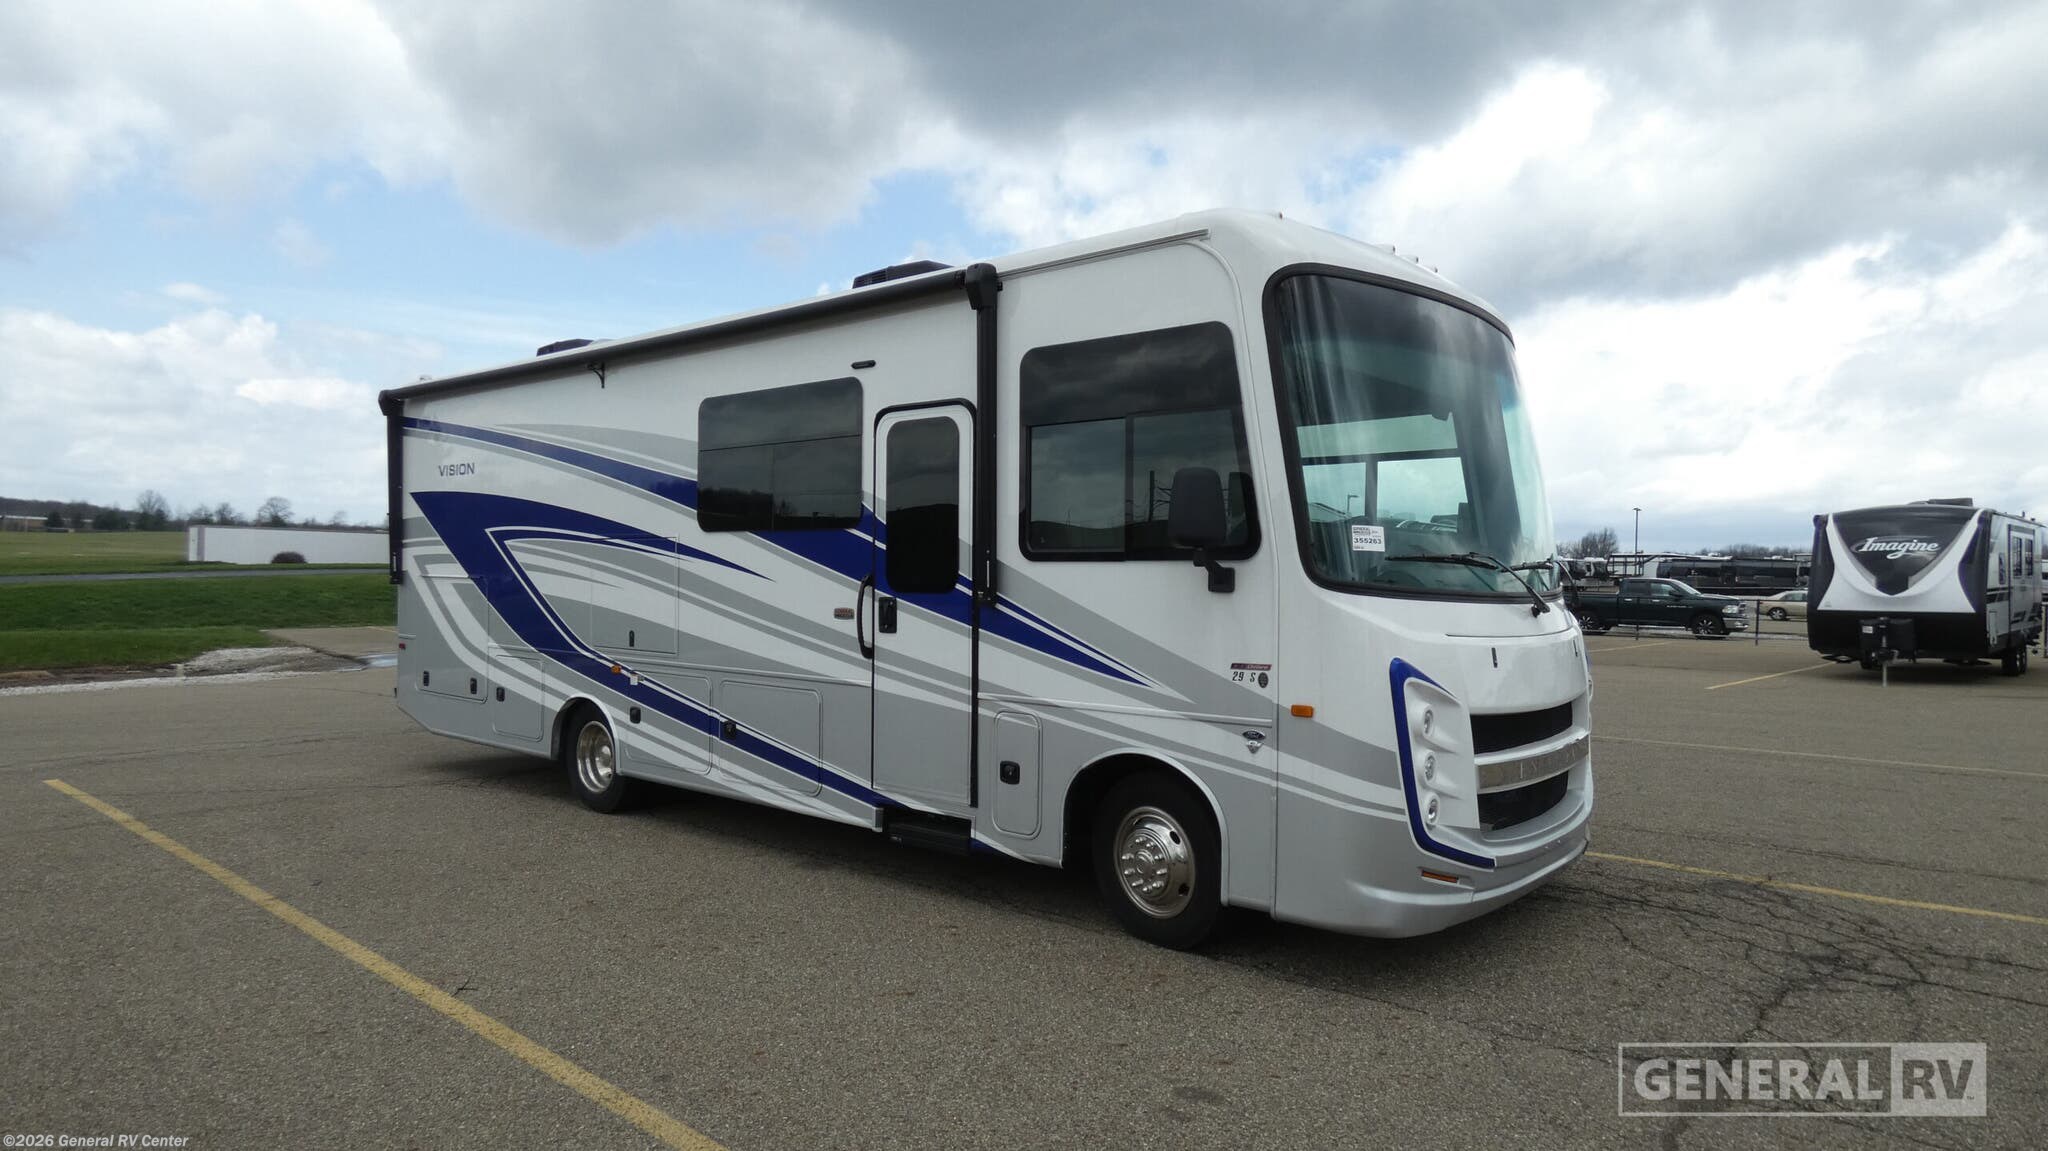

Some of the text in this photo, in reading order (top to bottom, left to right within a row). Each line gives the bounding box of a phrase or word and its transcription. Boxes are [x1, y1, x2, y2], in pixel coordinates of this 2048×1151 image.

[438, 462, 475, 477] VISION
[1858, 536, 1940, 560] Imagine
[1232, 671, 1245, 682] 29
